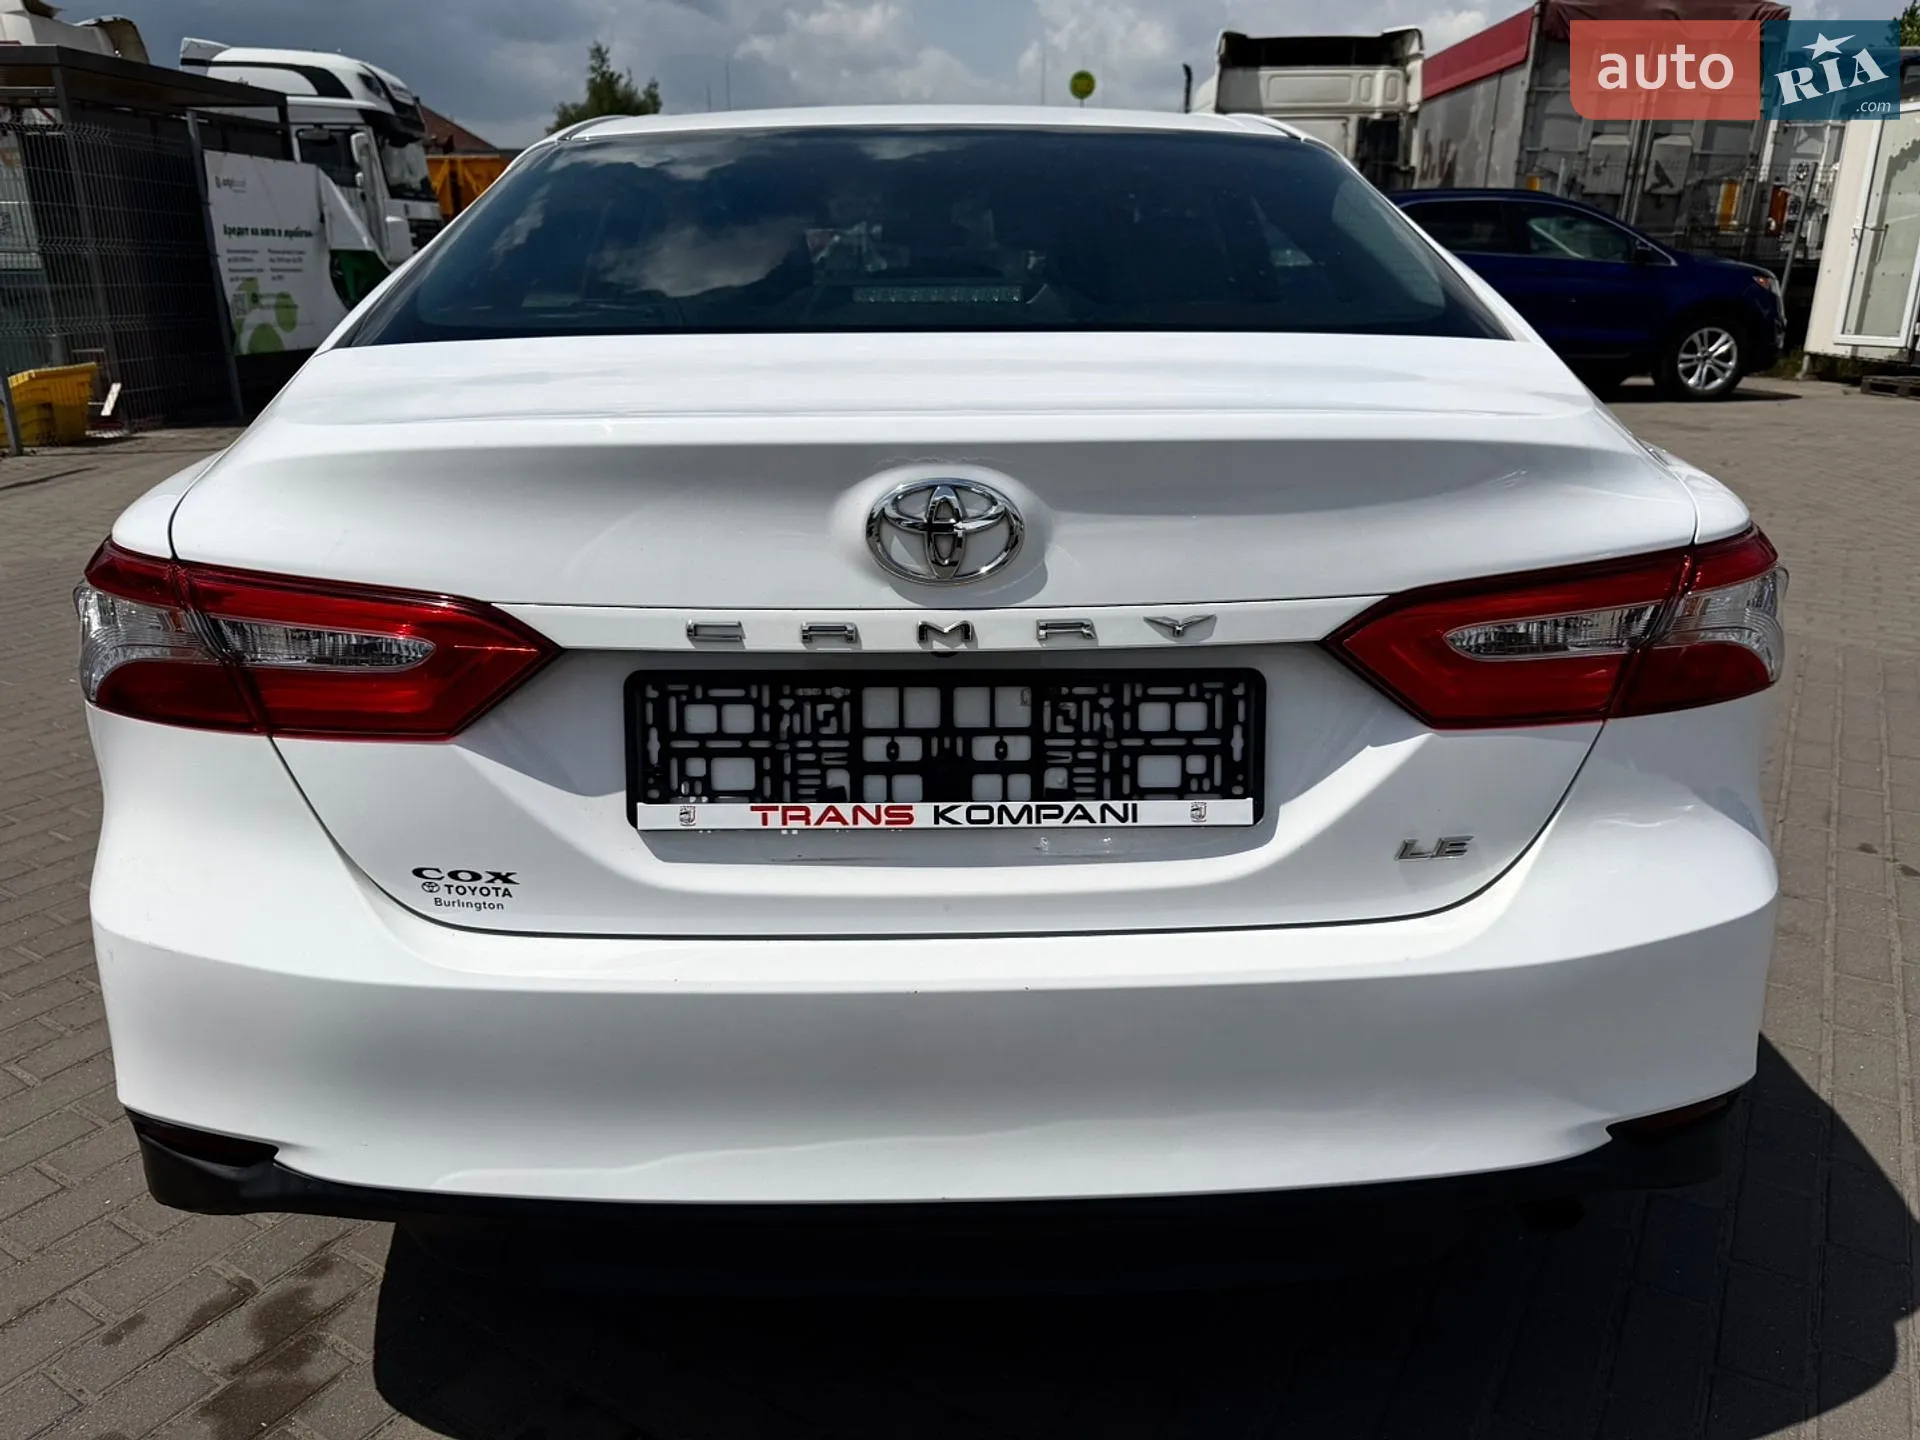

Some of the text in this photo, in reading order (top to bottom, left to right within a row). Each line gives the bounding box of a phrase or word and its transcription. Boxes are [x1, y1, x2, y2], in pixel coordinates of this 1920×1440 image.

[686, 614, 1217, 643] CAMRY
[749, 803, 1138, 826] TRANS KOMPANI
[1394, 834, 1474, 861] LE
[412, 867, 520, 885] COX
[444, 884, 513, 898] TOYOTA
[434, 897, 505, 911] Burlington
